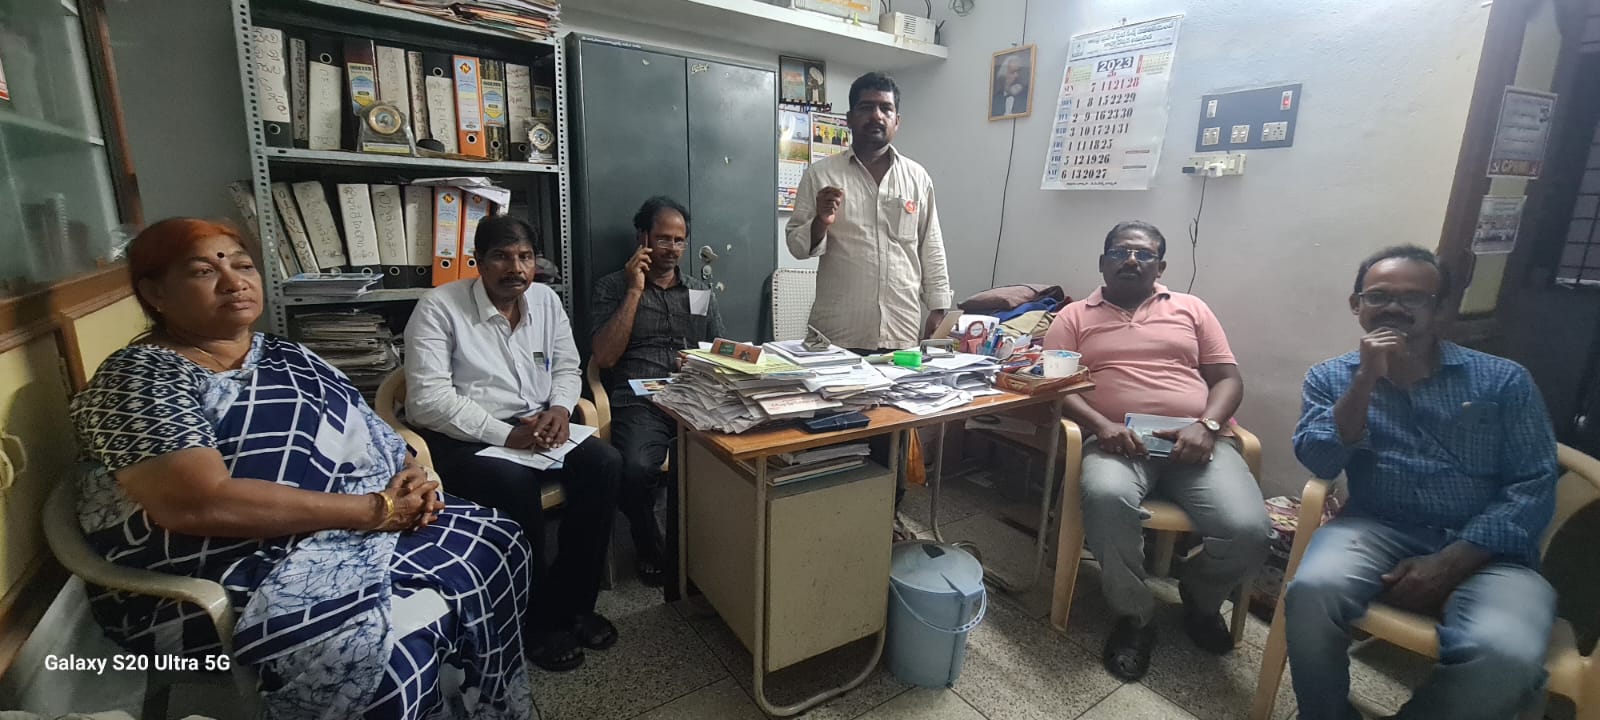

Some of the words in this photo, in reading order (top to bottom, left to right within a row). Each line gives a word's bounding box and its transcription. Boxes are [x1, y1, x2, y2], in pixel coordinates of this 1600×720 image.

[1099, 57, 1133, 72] 2023
[1091, 82, 1096, 92] 7
[1098, 95, 1109, 106] 15
[1110, 94, 1122, 105] 22
[1123, 92, 1136, 103] 29
[1072, 113, 1078, 123] 2
[1084, 112, 1091, 122] 9
[1095, 111, 1106, 121] 16
[1107, 109, 1119, 120] 23
[1120, 108, 1133, 118] 30
[1069, 126, 1075, 137] 3
[1080, 126, 1090, 136] 10
[1092, 125, 1103, 136] 17
[1117, 123, 1129, 134] 31
[1089, 140, 1100, 150] 18
[1101, 139, 1113, 150] 25
[1074, 155, 1085, 165] 12
[1086, 154, 1097, 165] 19
[1098, 153, 1111, 164] 26
[1061, 170, 1067, 179] 6
[1071, 169, 1082, 179] 13
[1083, 169, 1095, 179] 20
[1095, 168, 1108, 179] 27
